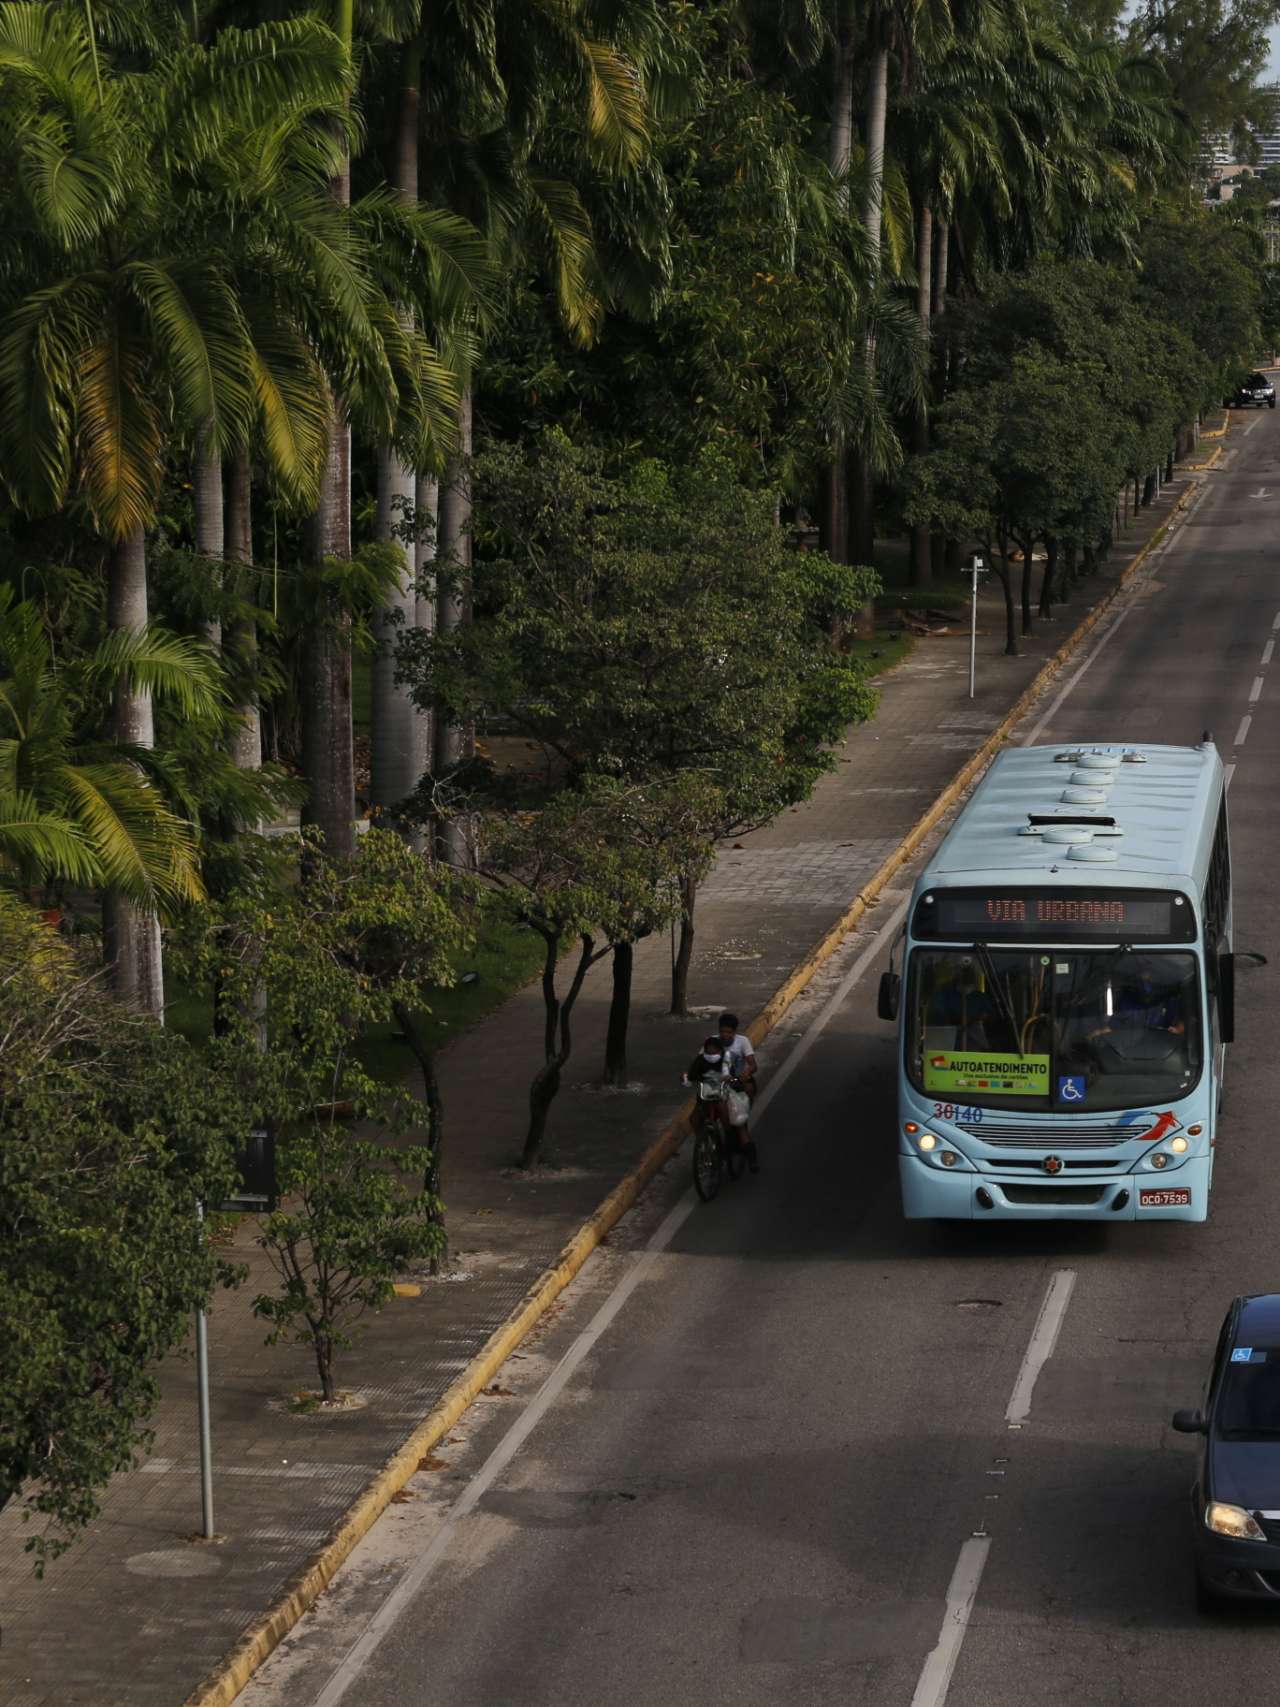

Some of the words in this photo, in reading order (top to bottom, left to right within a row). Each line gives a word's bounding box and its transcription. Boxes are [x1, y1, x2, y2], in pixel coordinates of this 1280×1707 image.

[985, 900, 1025, 921] VIA
[1038, 900, 1125, 922] URBANA
[949, 1061, 1047, 1074] AUTOATENDIMENTO
